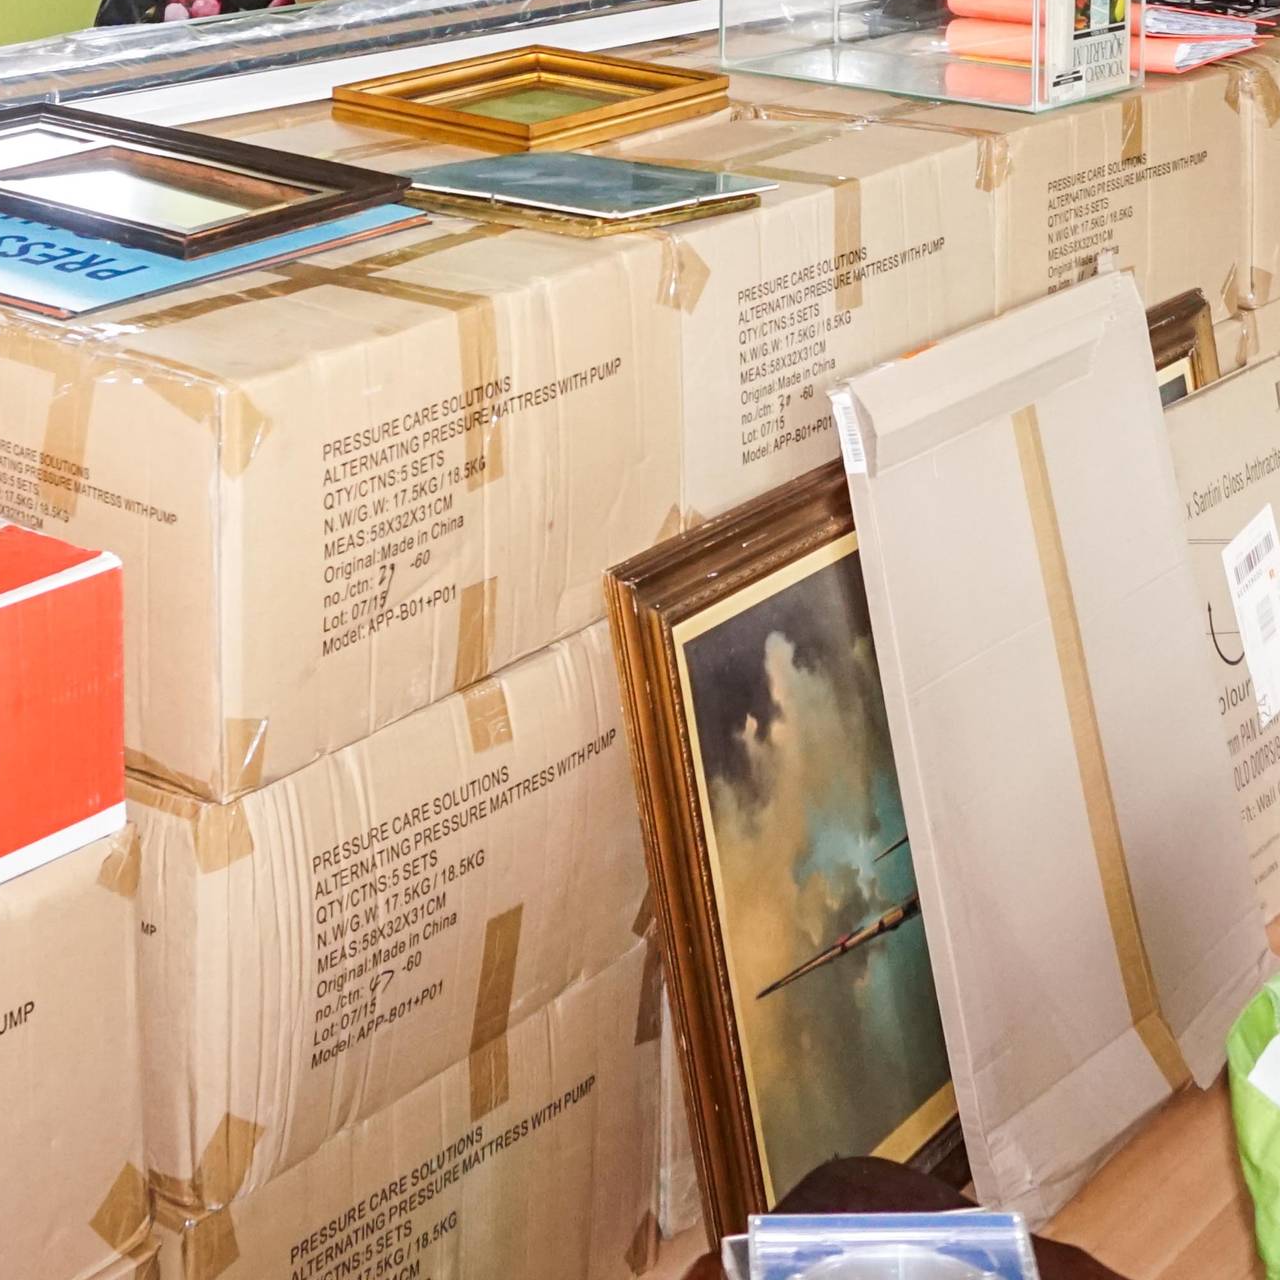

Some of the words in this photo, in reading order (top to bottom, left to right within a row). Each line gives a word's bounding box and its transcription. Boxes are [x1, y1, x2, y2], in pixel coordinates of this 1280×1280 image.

[1048, 172, 1086, 194] PRESSURE
[1088, 165, 1106, 182] CARE
[1091, 197, 1109, 214] SETS
[738, 276, 789, 305] PRESSURE
[791, 265, 815, 286] CARE
[817, 247, 867, 277] SOLUTIONS
[738, 290, 803, 326] ALTERNATING
[804, 272, 851, 299] PRESSURE
[853, 254, 899, 282] MATTRESS
[900, 245, 920, 265] WITH
[921, 237, 944, 257] PUMP
[786, 324, 816, 347] 17.5KG
[822, 310, 852, 333] 18.5KG
[797, 303, 820, 323] SETS
[740, 340, 826, 385] MEAS:58X32X31CM
[322, 420, 400, 462] PRESSURE
[402, 403, 439, 433] CARE
[442, 376, 511, 416] SOLUTIONS
[323, 435, 420, 488] ALTERNATING
[422, 408, 489, 449] PRESSURE
[490, 382, 557, 422] MATTRESS
[558, 369, 588, 396] WITH
[590, 357, 621, 384] PUMP
[742, 444, 771, 465] Model:
[773, 416, 832, 453] APP-B01+P01
[13, 445, 38, 463] CARE
[40, 452, 90, 480] SOLUTIONS
[324, 462, 409, 510] QTY/CTNS:5
[411, 450, 445, 476] SETS
[394, 476, 438, 508] 17.5KG
[448, 454, 486, 487] 18.5KG
[25, 463, 72, 491] PRESSURE
[74, 479, 122, 508] MATTRESS
[123, 498, 148, 516] WITH
[149, 506, 178, 526] PUMP
[1193, 479, 1221, 516] Santini
[1222, 471, 1244, 499] Gloss
[324, 493, 453, 561] MEAS:58X32X31CM
[416, 524, 427, 546] in
[431, 514, 464, 540] China
[322, 627, 364, 656] Model:
[368, 584, 456, 638] APP-B01+P01
[323, 611, 348, 634] Lot:
[351, 590, 387, 620] 07/15
[312, 821, 389, 875] PRESSURE
[392, 802, 430, 836] CARE
[433, 766, 509, 818] SOLUTIONS
[314, 838, 411, 901] ALTERNATING
[414, 800, 488, 849] PRESSURE
[489, 766, 555, 815] MATTRESS
[556, 748, 586, 778] WITH
[587, 728, 617, 761] PUMP
[1257, 785, 1277, 813] Wall
[316, 867, 400, 925] QTY/CTNS:5
[403, 849, 438, 880] SETS
[385, 874, 431, 912] 17.5KG
[441, 849, 485, 886] 18.5KG
[317, 892, 446, 975] MEAS:58X32X31CM
[409, 929, 420, 952] in
[423, 911, 458, 942] China
[402, 950, 422, 974] -60
[311, 1034, 356, 1069] Model:
[357, 980, 444, 1048] APP-B01+P01
[290, 1200, 366, 1265] PRESSURE
[369, 1175, 408, 1213] CARE
[410, 1125, 484, 1187] SOLUTIONS
[291, 1212, 386, 1280] ALTERNATING
[388, 1163, 460, 1221] PRESSURE
[461, 1120, 529, 1177] MATTRESS
[530, 1100, 562, 1131] WITH
[564, 1075, 596, 1109] PUMP
